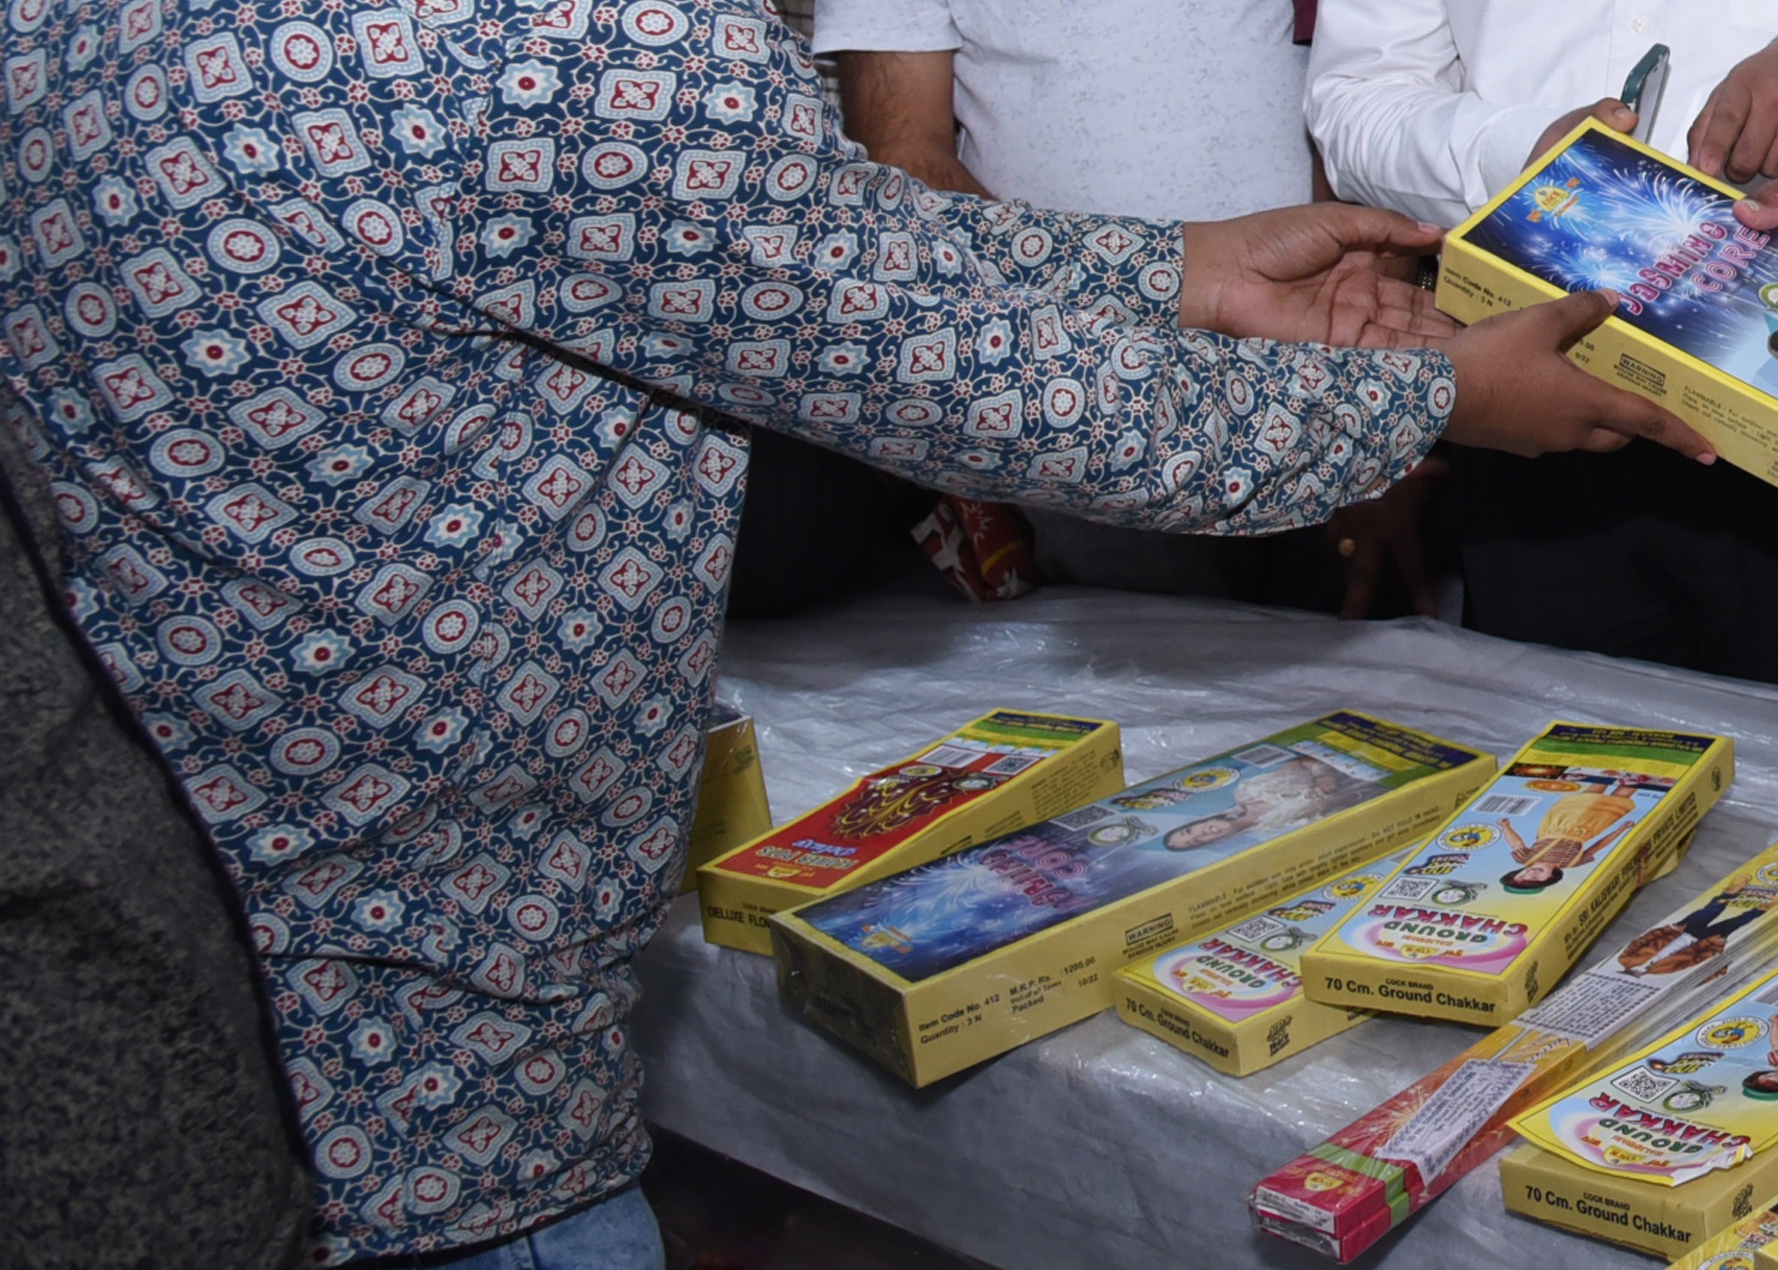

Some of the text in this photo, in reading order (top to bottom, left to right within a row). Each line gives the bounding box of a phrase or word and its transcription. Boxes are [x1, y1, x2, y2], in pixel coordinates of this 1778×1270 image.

[1689, 218, 1770, 300] CORE
[1441, 275, 1475, 298] Quantity
[1461, 275, 1483, 292] Code
[1496, 294, 1513, 308] 412
[1620, 356, 1665, 384] WARNING
[1575, 909, 1591, 925] SRI
[1651, 812, 1678, 842] PRIVATE
[1671, 790, 1699, 819] LIMITED
[706, 905, 768, 927] DELUXE FLO
[1126, 917, 1172, 942] WARNING
[1367, 902, 1528, 938] CHAKKAR
[1383, 919, 1487, 943] GROUND
[1063, 956, 1096, 974] 1205.00
[1195, 953, 1266, 990] GROUND
[1197, 933, 1305, 993] CHAKKAR
[1323, 976, 1496, 1013] 70 Cm. Ground Chakkar
[1384, 977, 1434, 991] COCK BRAND
[918, 1017, 939, 1032] Item
[940, 1007, 964, 1023] Code
[983, 993, 1000, 1006] 412
[1011, 995, 1045, 1014] Packed
[919, 1023, 960, 1044] Quantity
[973, 1013, 982, 1022] N
[1122, 997, 1139, 1012] 70
[1137, 1004, 1158, 1021] Cm.
[1154, 1013, 1192, 1039] Ground
[1189, 1031, 1231, 1058] Chakkar
[1597, 1116, 1703, 1157] GROUND
[1523, 1185, 1692, 1243] 70 Cm. Ground Chakkar
[1582, 1192, 1630, 1211] COCK BRAND
